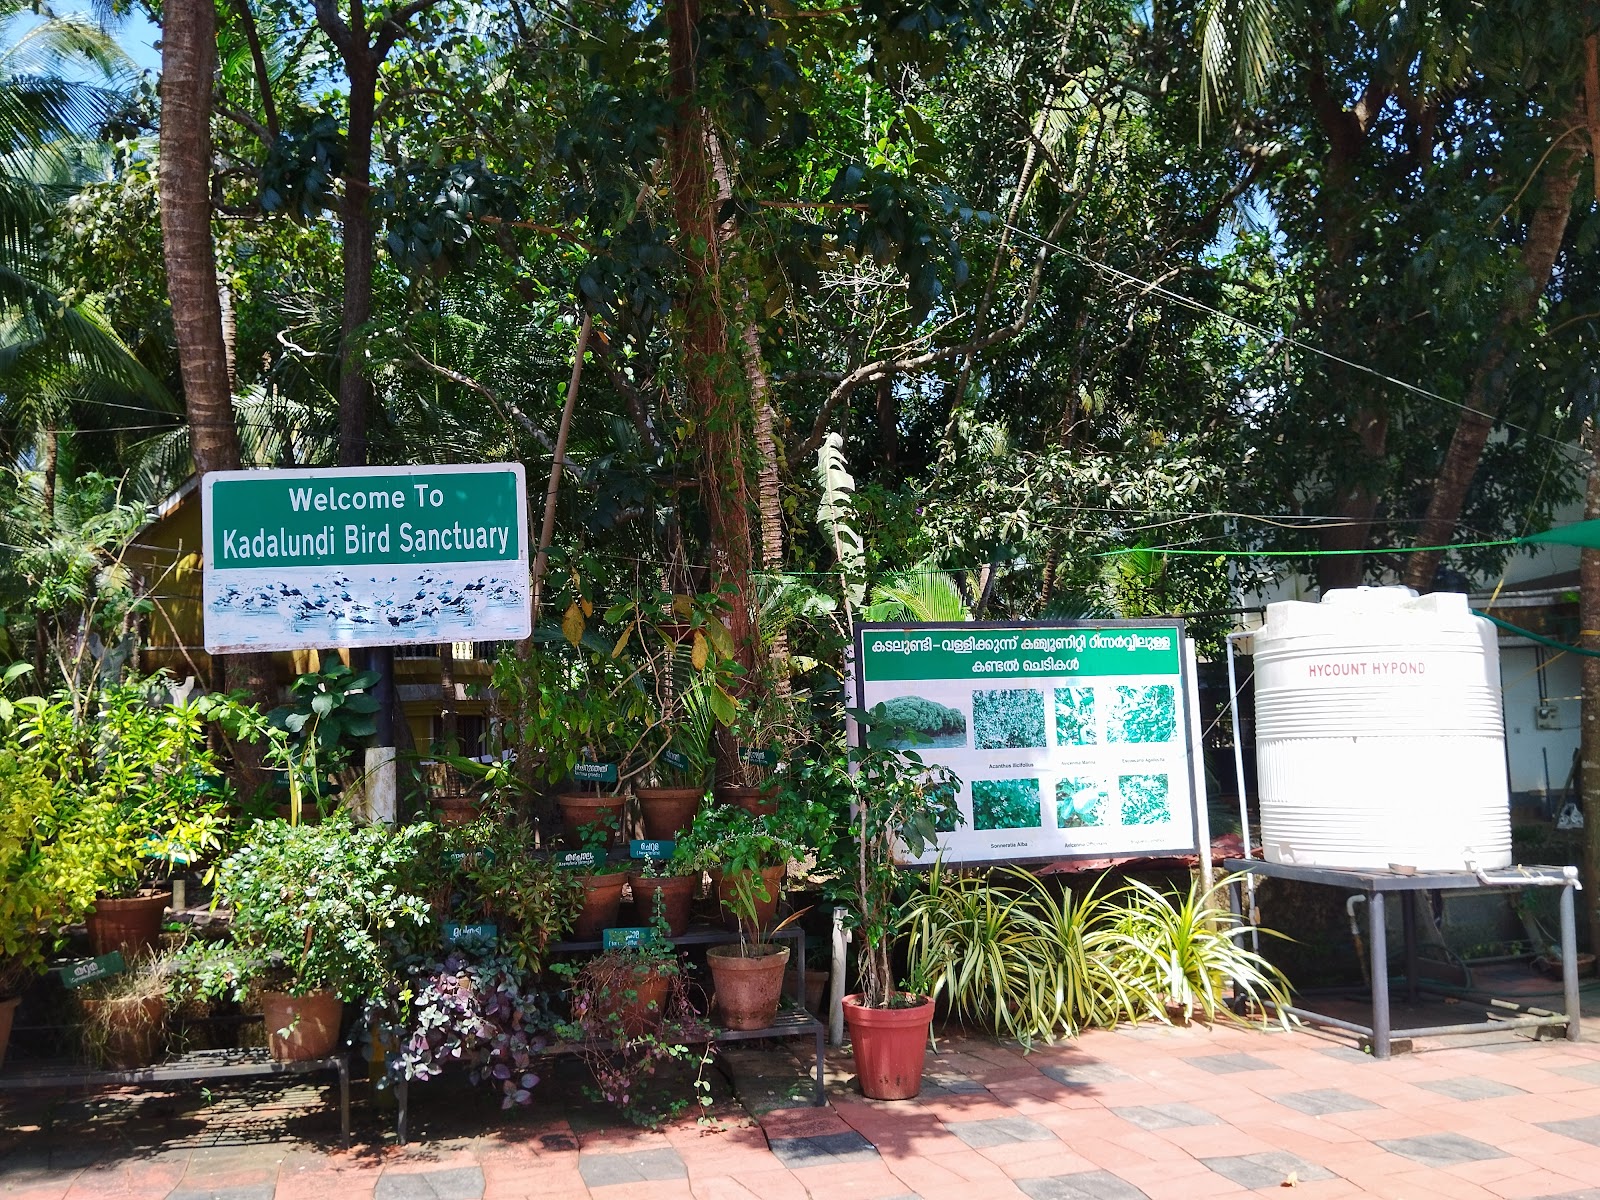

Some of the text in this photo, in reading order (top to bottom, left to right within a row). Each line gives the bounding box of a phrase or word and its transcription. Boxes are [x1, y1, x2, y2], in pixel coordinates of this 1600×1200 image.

[289, 483, 443, 512] Welcome To
[223, 520, 509, 559] Kadalundi Bird Sanctuary
[972, 656, 1080, 673] കണ്ടൽ ചെടികൾ
[1309, 662, 1426, 677] HYCOUNT HYPOND
